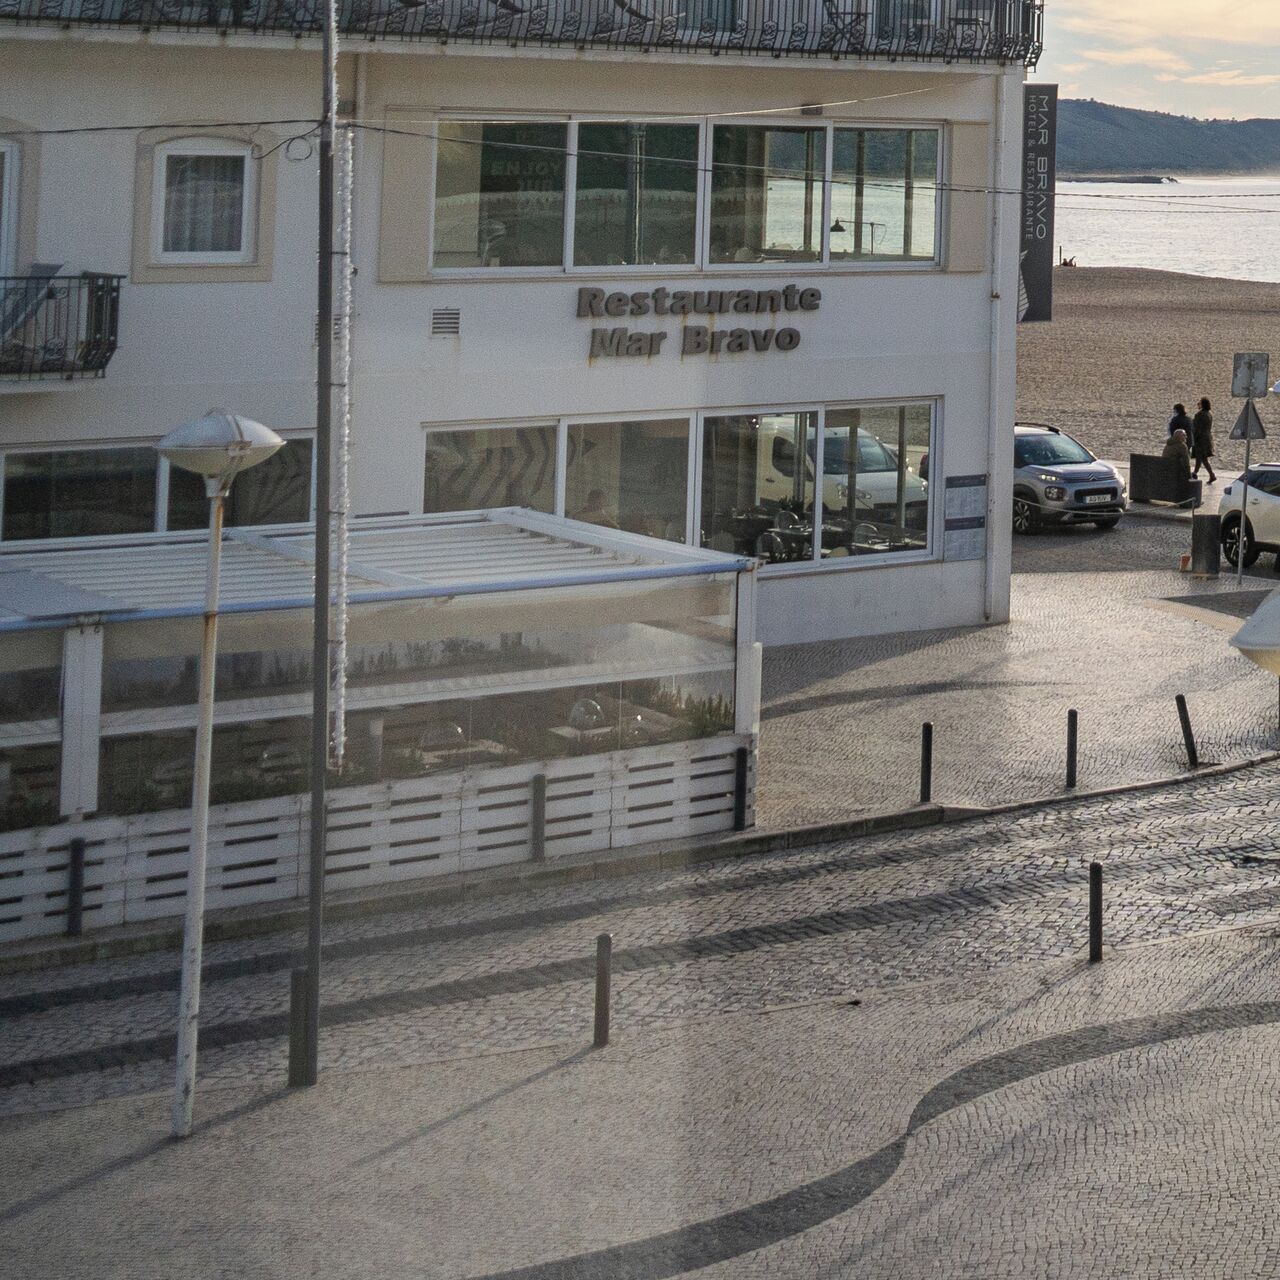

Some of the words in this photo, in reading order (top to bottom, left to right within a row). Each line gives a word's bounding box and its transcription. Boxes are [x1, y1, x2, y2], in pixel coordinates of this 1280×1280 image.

[1028, 95, 1037, 134] HOTEL
[1038, 95, 1049, 145] MAR
[1025, 152, 1036, 240] RESTAURANTE
[1036, 157, 1048, 239] BRAVO
[576, 284, 822, 318] Restaurante
[589, 326, 667, 358] Mar
[682, 325, 801, 355] Bravo
